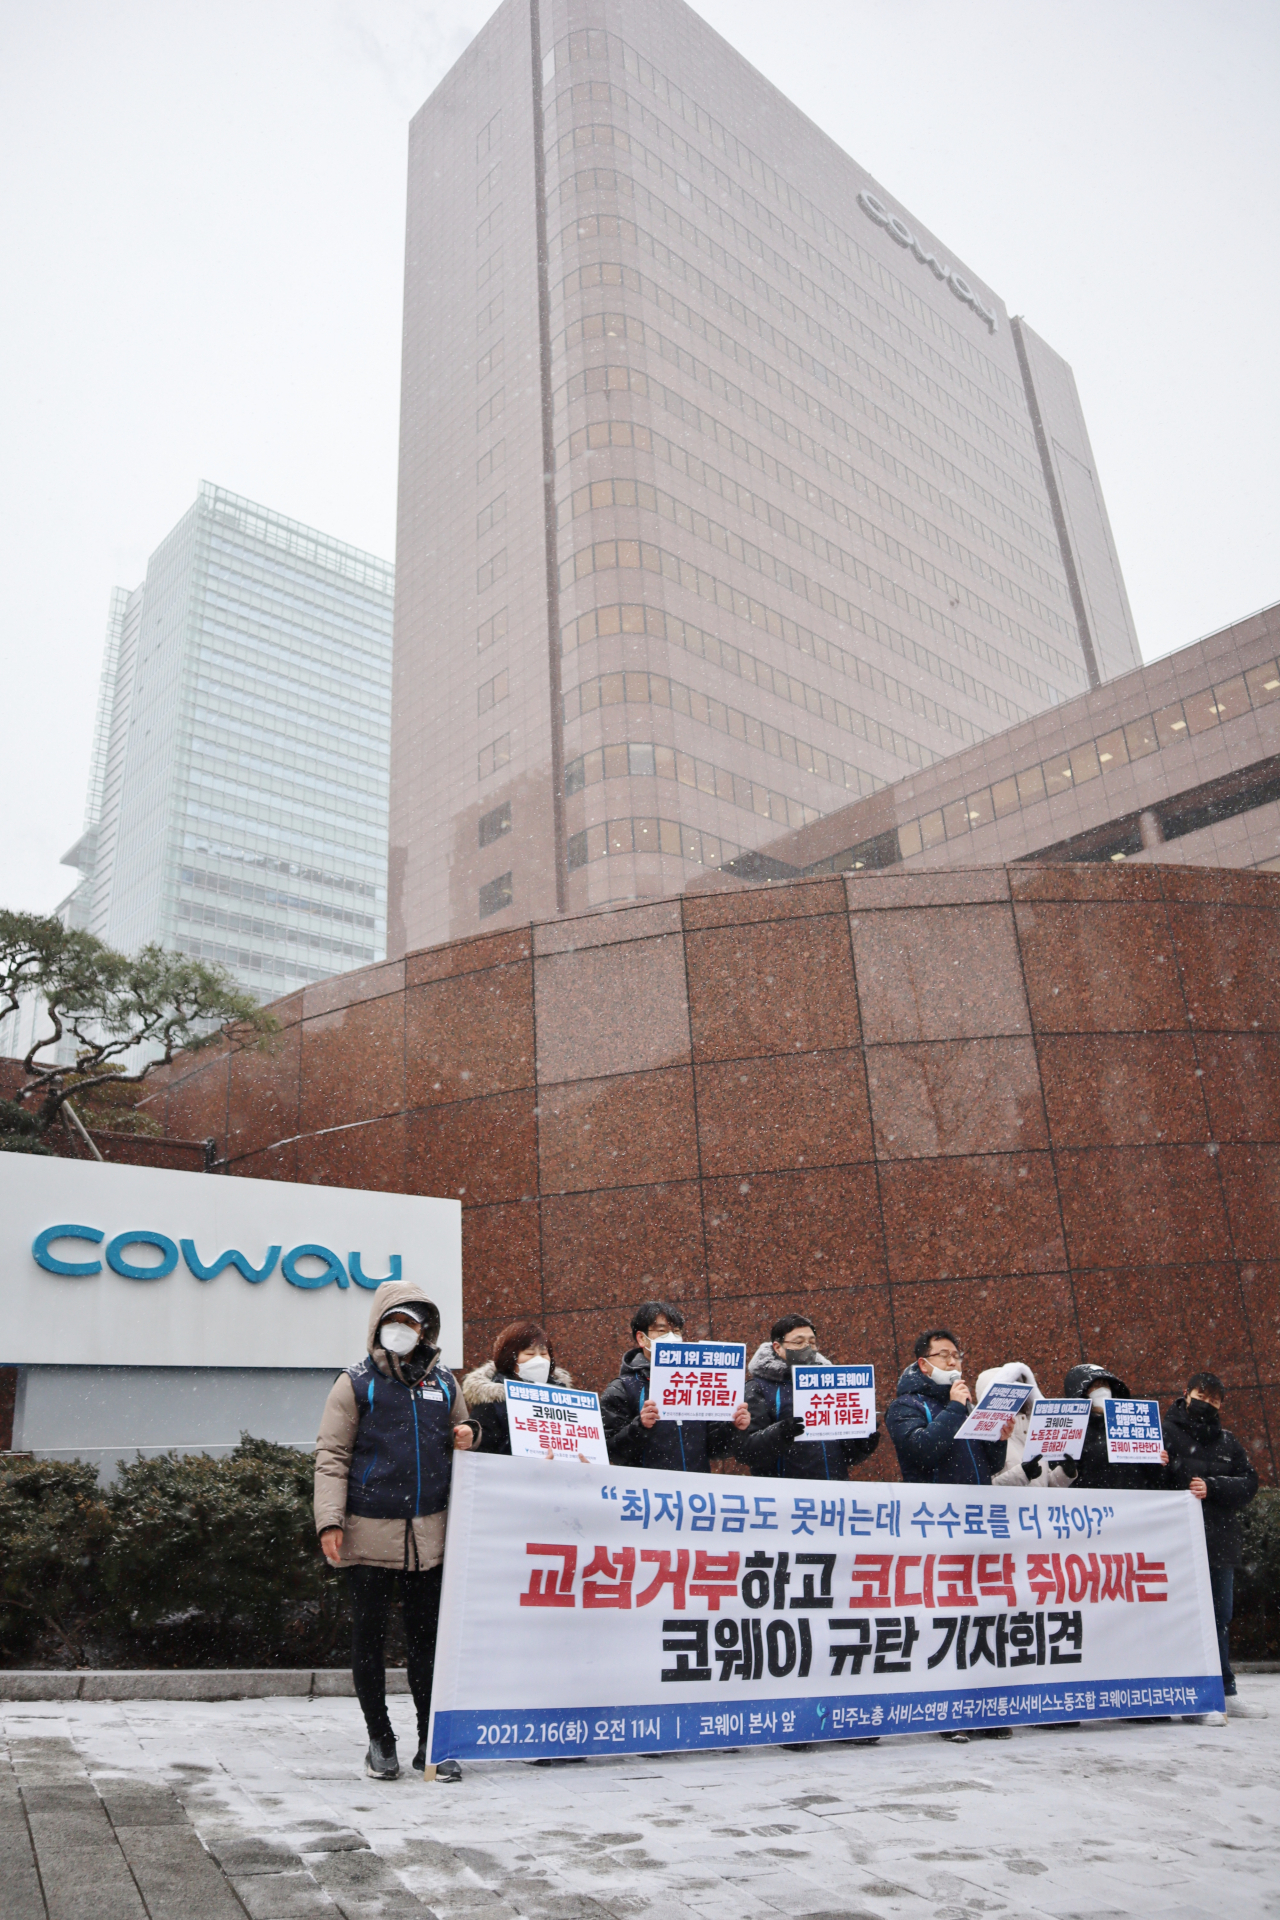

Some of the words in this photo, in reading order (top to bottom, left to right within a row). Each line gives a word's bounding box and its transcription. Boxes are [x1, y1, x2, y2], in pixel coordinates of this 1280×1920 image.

[856, 189, 998, 336] coway
[32, 1224, 402, 1289] coway
[659, 1350, 682, 1365] 업계
[684, 1351, 699, 1365] 1위
[702, 1351, 740, 1366] 코웨이!
[670, 1371, 728, 1388] 수수료도
[799, 1373, 819, 1387] 업계
[821, 1373, 834, 1387] 1위
[837, 1373, 869, 1386] 코웨이!
[509, 1385, 550, 1402] 일방통행
[552, 1392, 594, 1408] 이제그만!
[663, 1389, 692, 1406] 업계
[696, 1390, 737, 1406] 1위로!
[810, 1393, 860, 1409] 수수료도
[532, 1405, 578, 1423] 코웨이는
[1035, 1403, 1060, 1414] 일방통행
[1061, 1403, 1089, 1414] 이제그만!
[1114, 1402, 1135, 1414] 교섭은
[1135, 1403, 1149, 1414] 거부
[805, 1410, 830, 1426] 업계
[834, 1409, 869, 1425] 1위로!
[1044, 1417, 1073, 1428] 코웨이는
[1116, 1414, 1150, 1426] 일방적으로
[515, 1417, 561, 1435] 노동조합
[565, 1423, 600, 1440] 교섭에
[1030, 1429, 1060, 1441] 노동조합
[1060, 1429, 1083, 1440] 교섭에
[1110, 1426, 1130, 1438] 수수료
[1146, 1428, 1160, 1438] 시도
[539, 1435, 578, 1452] 응해라!
[1041, 1441, 1067, 1453] 응해라!
[1110, 1442, 1130, 1453] 코웨이
[1132, 1442, 1160, 1453] 규탄한다!
[601, 1485, 778, 1533] “최저임금도
[791, 1498, 900, 1537] 못버는데
[910, 1502, 1010, 1538] 수수료를
[1019, 1504, 1042, 1539] 더
[1048, 1504, 1114, 1539] 깎아?”
[520, 1542, 837, 1611] 교섭거부하고
[849, 1552, 1017, 1609] 코디코닥
[1026, 1552, 1168, 1606] 쥐어짜는
[660, 1618, 812, 1682] 코웨이
[828, 1616, 919, 1676] 규탄
[927, 1610, 1083, 1670] 기자회견
[832, 1706, 884, 1729] 민주노총
[887, 1703, 948, 1724] 서비스연맹
[951, 1691, 1096, 1720] 전국가전통신서비스노동조합
[1099, 1686, 1198, 1708] 코웨이코디코닥지부
[476, 1720, 588, 1745] 2021.2.16(화)
[593, 1718, 625, 1742] 오전
[631, 1716, 661, 1740] 11시
[699, 1713, 744, 1736] 코웨이
[748, 1712, 777, 1735] 본사
[781, 1710, 796, 1733] 앞
